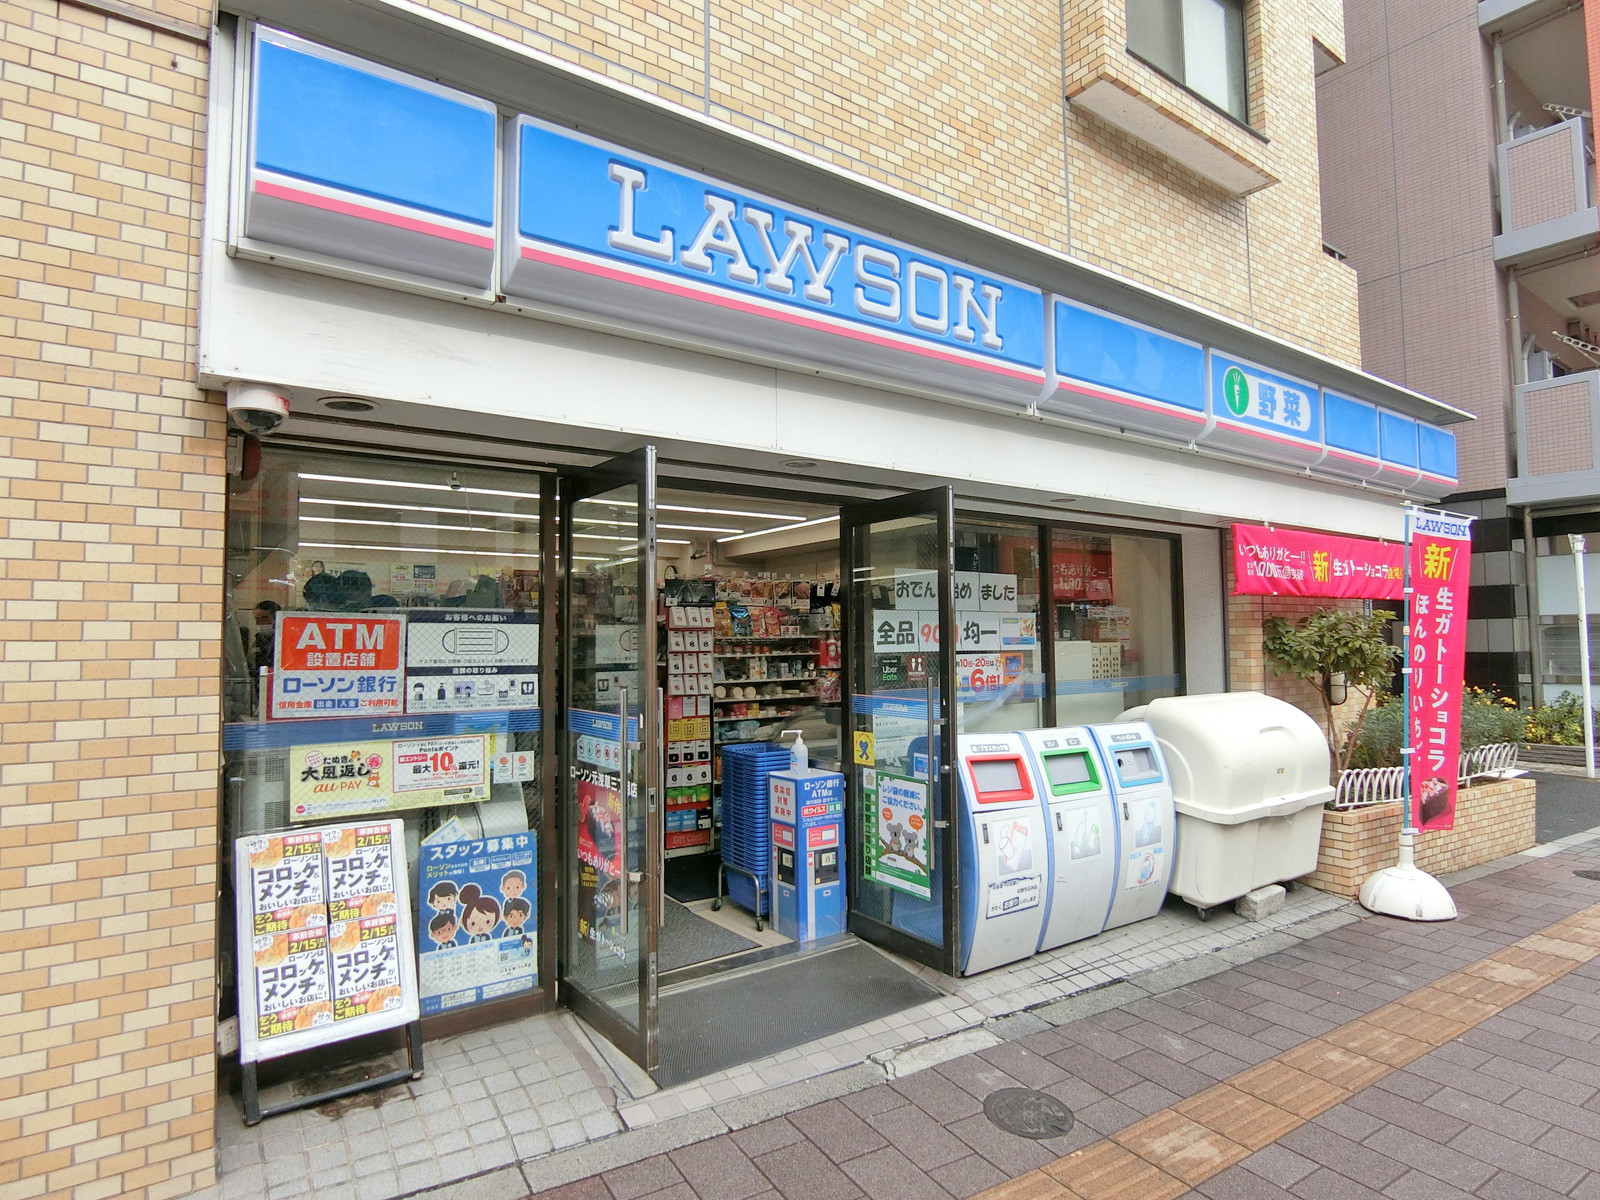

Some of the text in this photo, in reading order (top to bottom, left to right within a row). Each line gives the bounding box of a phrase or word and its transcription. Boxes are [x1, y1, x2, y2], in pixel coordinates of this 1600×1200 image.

[607, 162, 1003, 352] LAWSON
[1258, 382, 1301, 427] 野菜
[1415, 517, 1467, 537] LAWSON
[1313, 549, 1329, 583] 新
[1423, 543, 1452, 581] 新
[896, 580, 936, 599] おでん
[981, 584, 1015, 601] ました
[296, 622, 385, 650] ATM
[877, 620, 915, 646] 全品
[963, 621, 998, 645] 均一
[307, 652, 376, 667] 設置店舗
[882, 665, 898, 674] Uber
[283, 676, 397, 693] ローソン銀行
[1427, 586, 1454, 771] 生ガトーショコラ
[278, 700, 313, 709] 信用金庫
[316, 700, 333, 708] 出金
[360, 699, 399, 707] ご利用可能
[372, 721, 424, 733] LAWSON
[368, 756, 380, 768] 春
[301, 763, 371, 781] 大恩返し
[313, 780, 362, 793] au PAY
[773, 784, 791, 796] 感染症
[804, 779, 840, 791] ローソン銀行
[774, 806, 792, 818] 実施中
[356, 845, 389, 855] ローソンは
[430, 835, 528, 861] スタッフ募集中
[284, 854, 319, 865] ローソンは
[333, 883, 391, 899] おいしいお店に!
[259, 894, 321, 911] おいしいお店に!
[330, 907, 360, 921] ご期待
[255, 920, 288, 935] ご期待
[360, 936, 394, 949] ローソンは
[288, 950, 324, 962] ローソンは
[339, 976, 397, 996] おいしいお店に!
[263, 991, 327, 1012] おいしいお店に!
[334, 1003, 366, 1020] ご期待
[259, 1020, 293, 1038] ご期待
